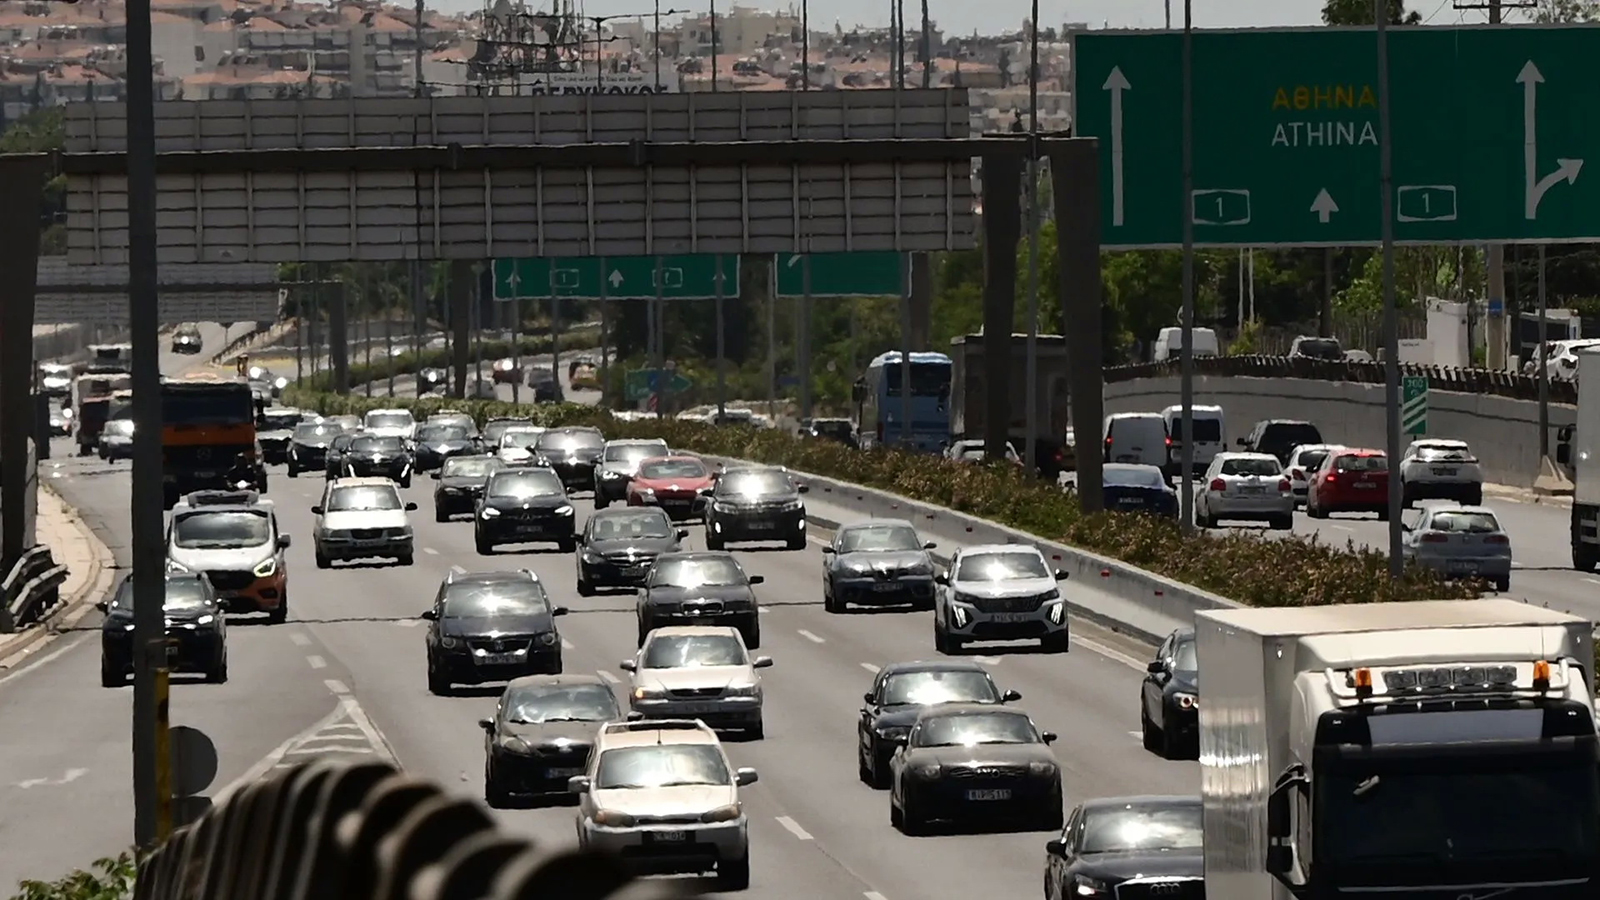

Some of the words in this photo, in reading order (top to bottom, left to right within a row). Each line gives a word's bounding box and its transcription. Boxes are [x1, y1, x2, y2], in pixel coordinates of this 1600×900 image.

[1271, 84, 1377, 110] ΑΘΗΝΑ
[1271, 121, 1378, 147] ATHINA
[1215, 197, 1223, 218] 1
[1421, 192, 1430, 214] 1
